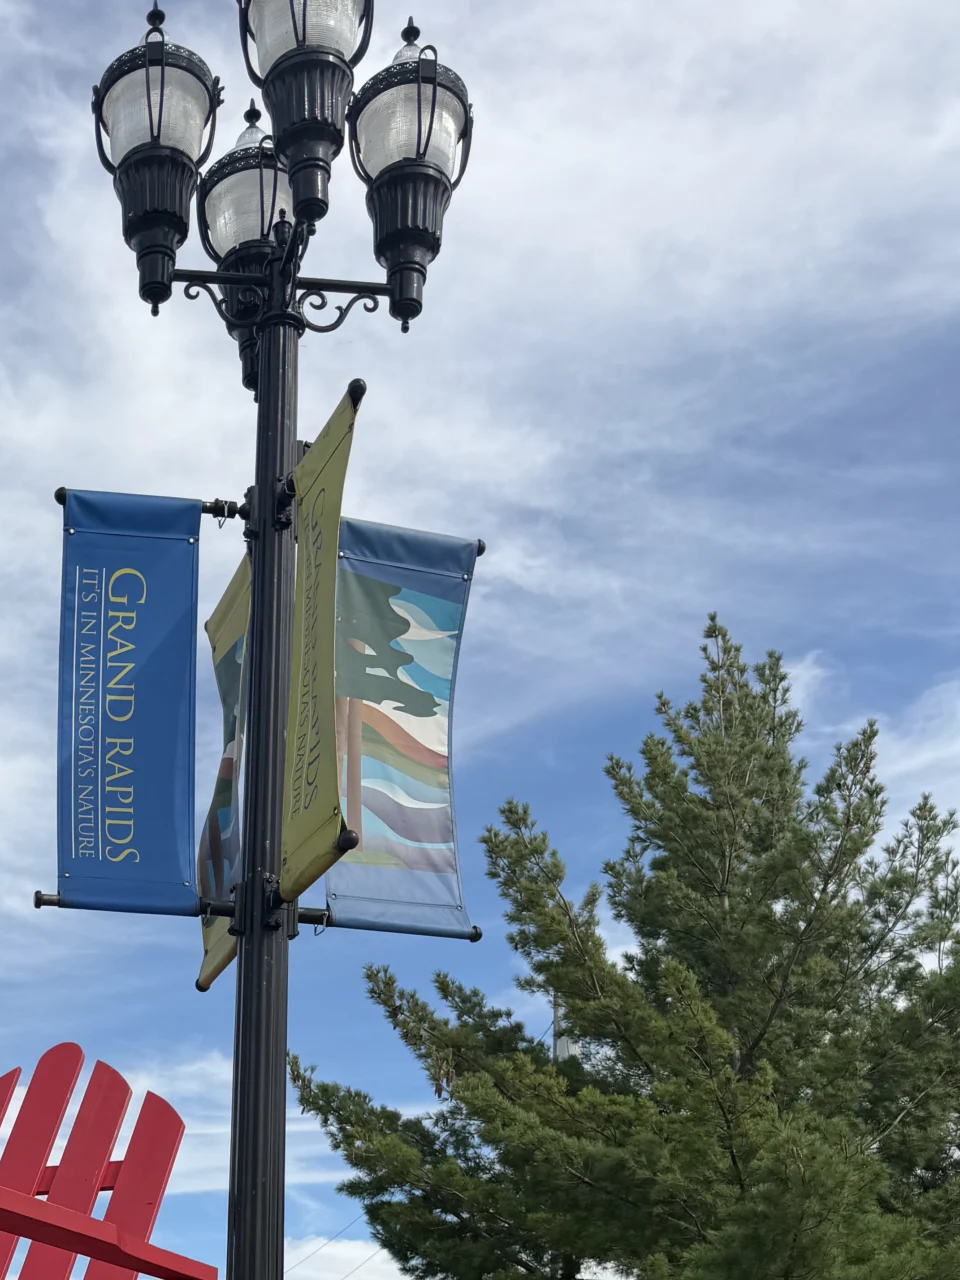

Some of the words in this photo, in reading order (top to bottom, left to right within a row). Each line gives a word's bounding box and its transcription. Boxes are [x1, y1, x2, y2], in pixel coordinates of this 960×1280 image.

[80, 611, 97, 635] IN
[81, 568, 100, 602] IT'S
[105, 567, 147, 722] GRAND
[78, 642, 96, 777] MINNESOTA'S
[105, 736, 140, 863] RAPIDS
[292, 733, 307, 820] NATURE
[78, 784, 95, 858] NATURE
